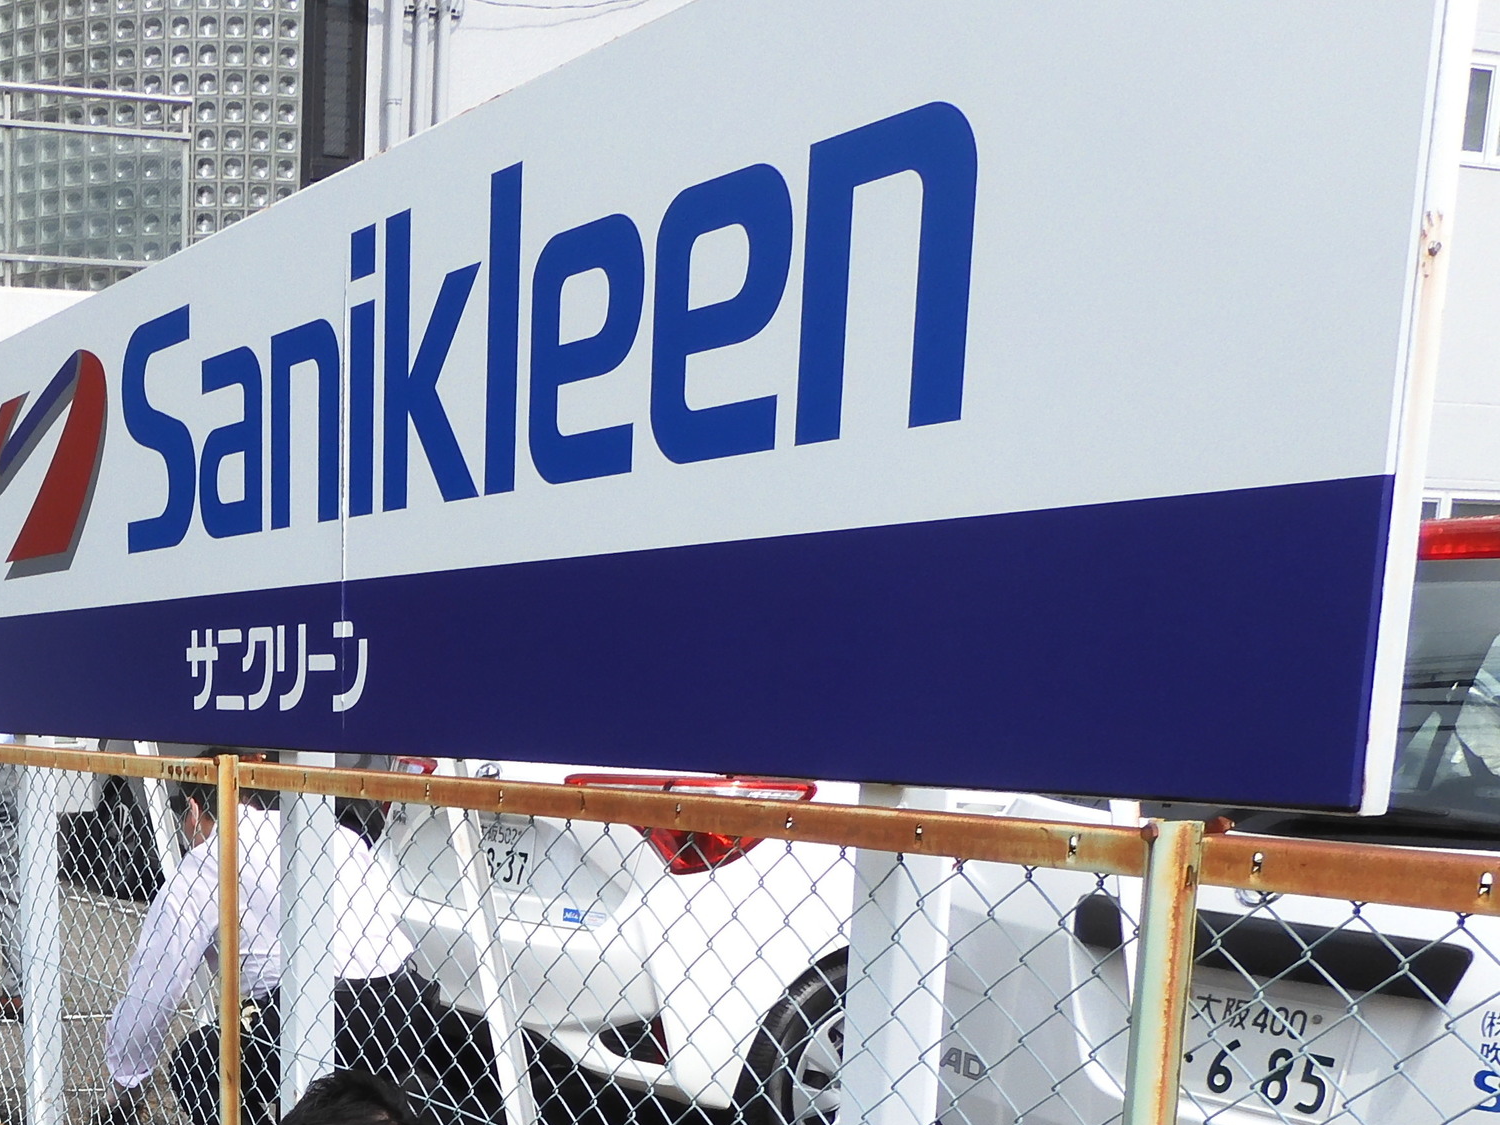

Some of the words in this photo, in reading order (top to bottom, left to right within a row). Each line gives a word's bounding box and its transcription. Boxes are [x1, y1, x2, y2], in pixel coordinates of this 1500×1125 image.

[122, 101, 977, 554] Sanikleen
[186, 621, 368, 712] サニクリーン
[939, 1047, 987, 1081] AD
